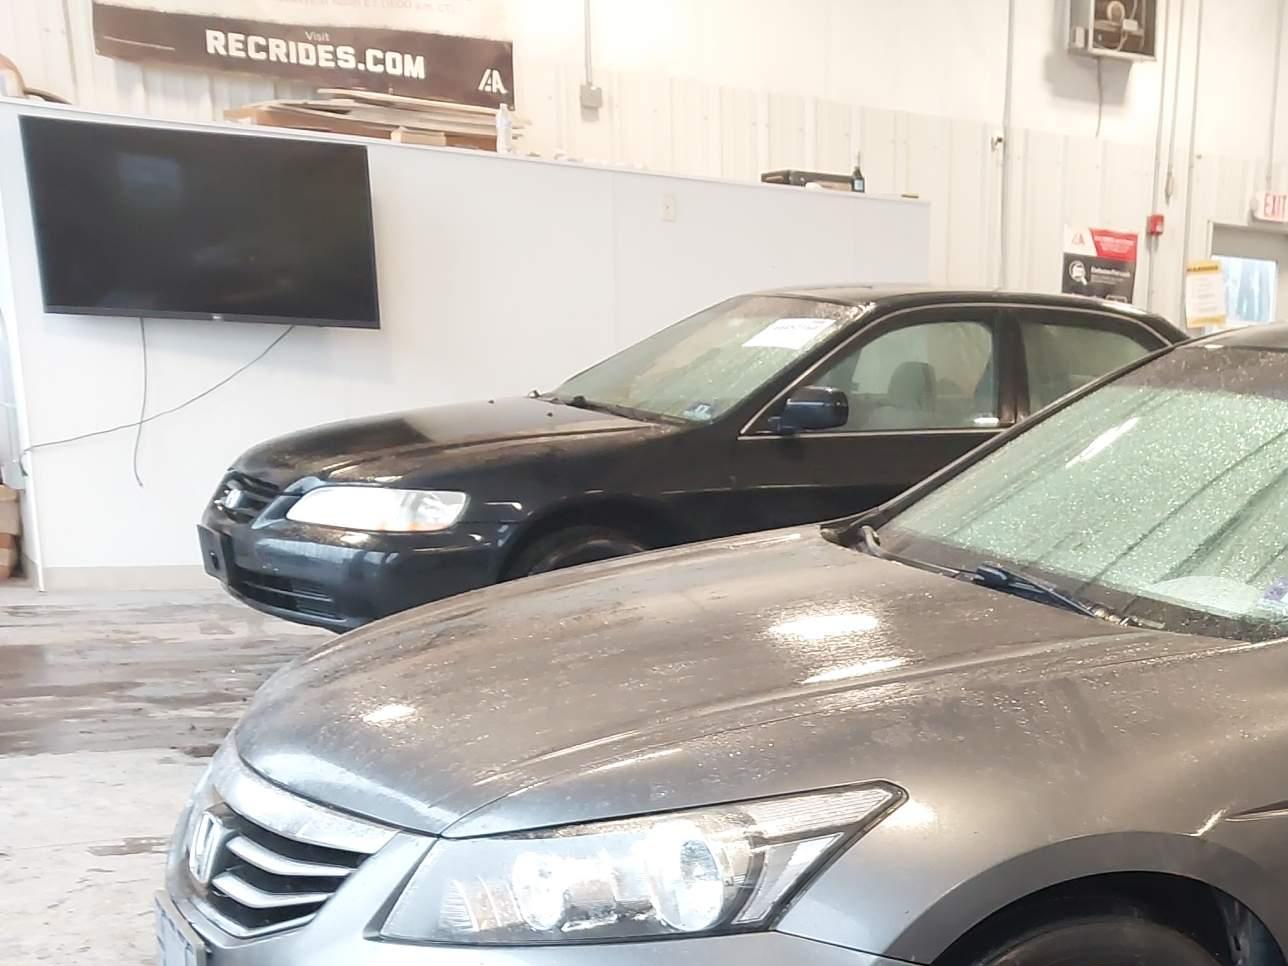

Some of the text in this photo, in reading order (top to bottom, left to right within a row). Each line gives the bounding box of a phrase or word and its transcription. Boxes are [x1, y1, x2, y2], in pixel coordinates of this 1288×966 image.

[305, 31, 330, 41] Visit
[206, 29, 425, 79] RECRIDES.COM
[1264, 193, 1287, 219] EXIT
